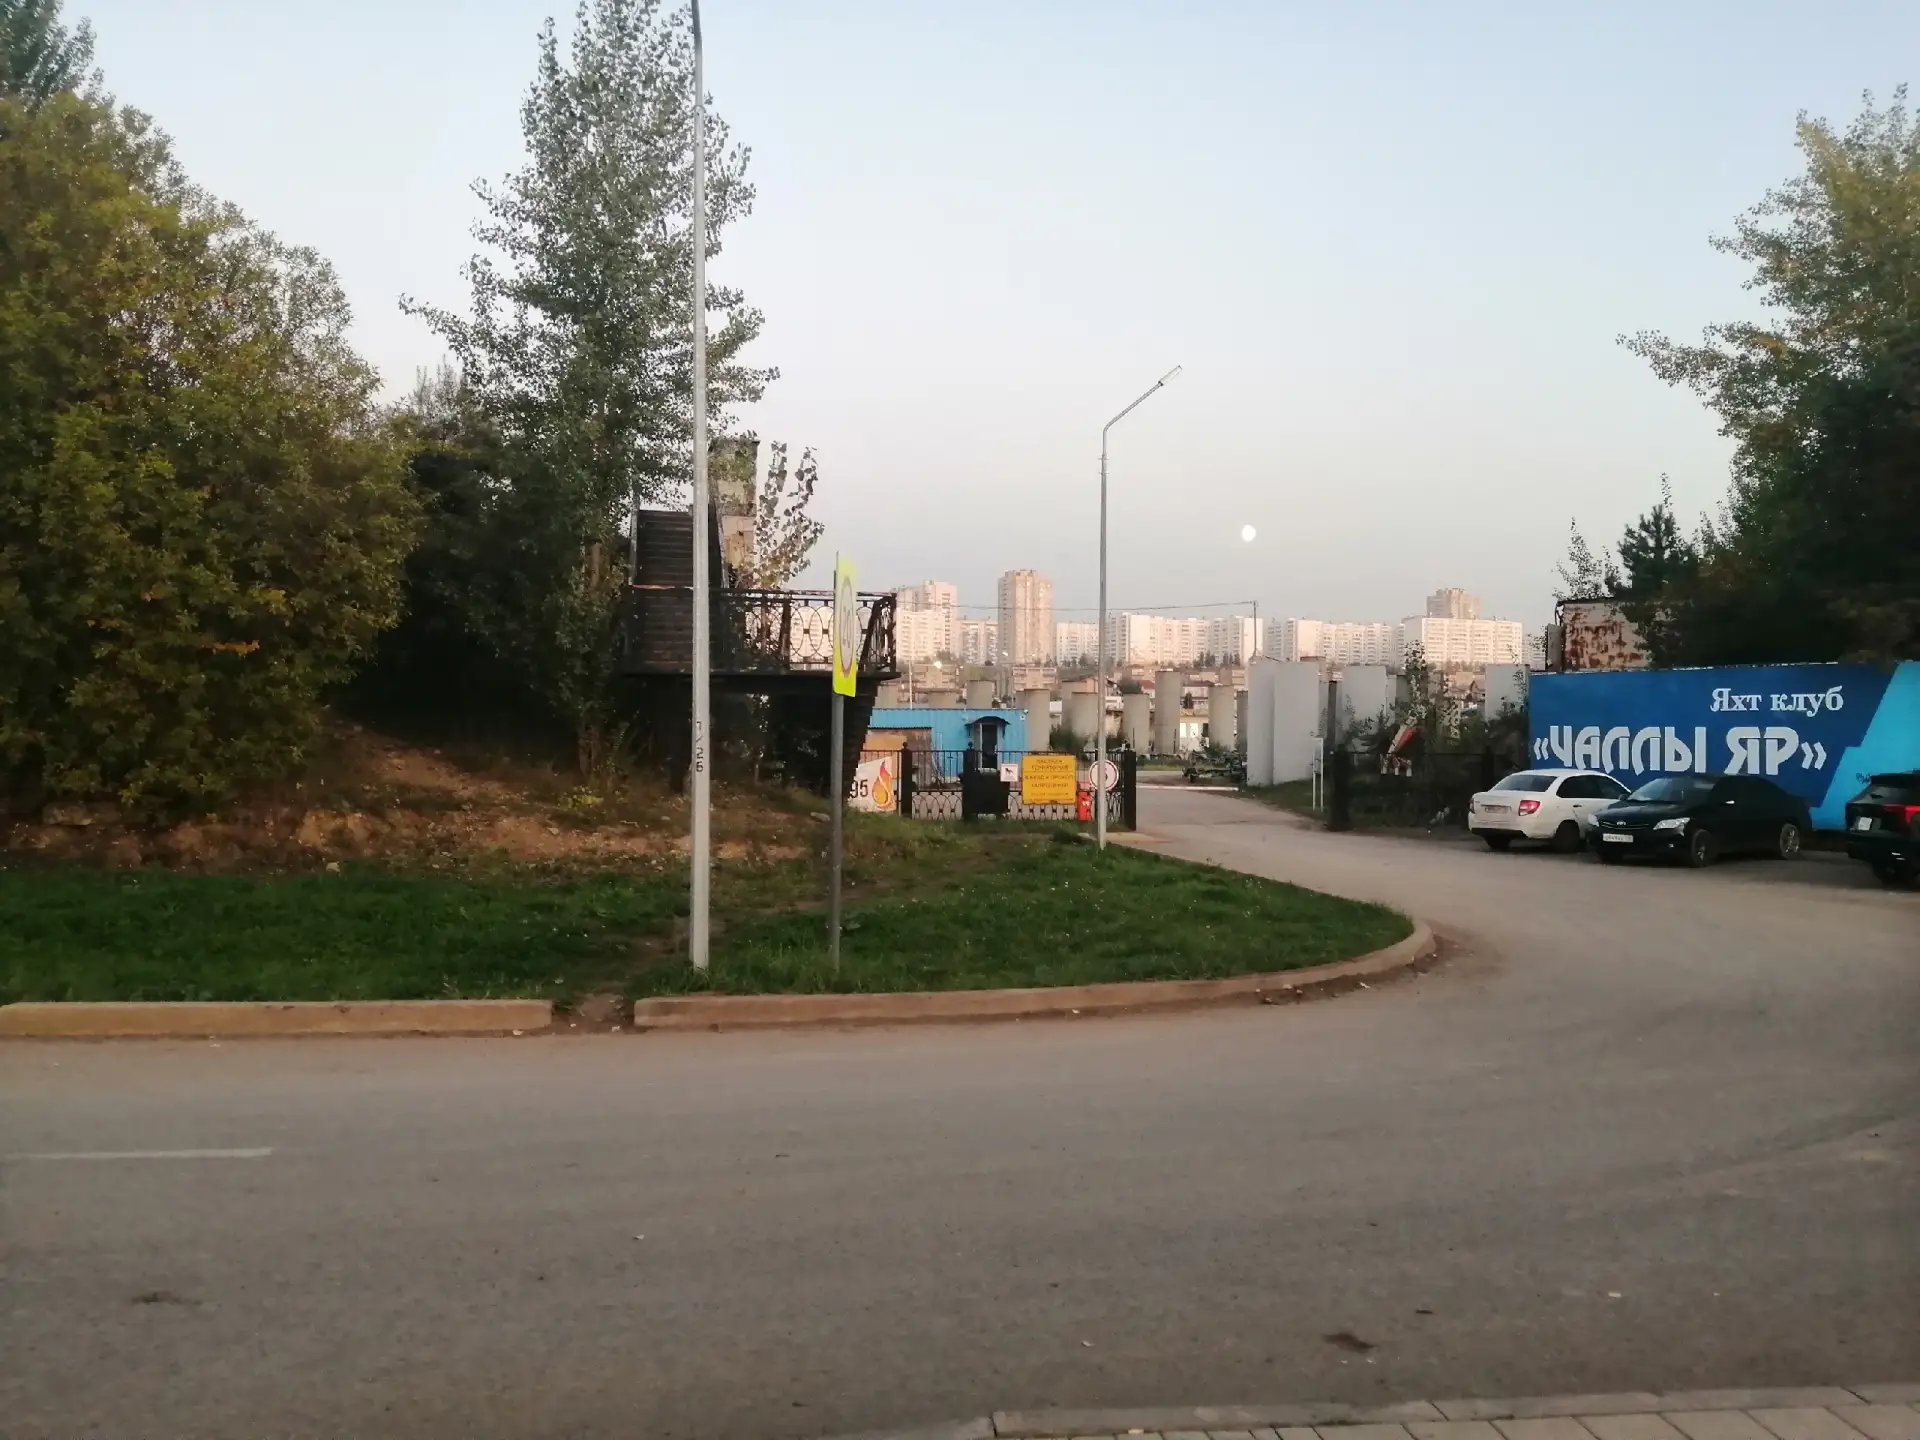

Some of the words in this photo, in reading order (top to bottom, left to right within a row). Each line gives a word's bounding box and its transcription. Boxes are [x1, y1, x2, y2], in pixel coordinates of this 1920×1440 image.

[1710, 687, 1762, 712] Яхт
[1769, 685, 1844, 718] клуб
[1723, 726, 1827, 776] ЯР»
[848, 779, 869, 799] 95
